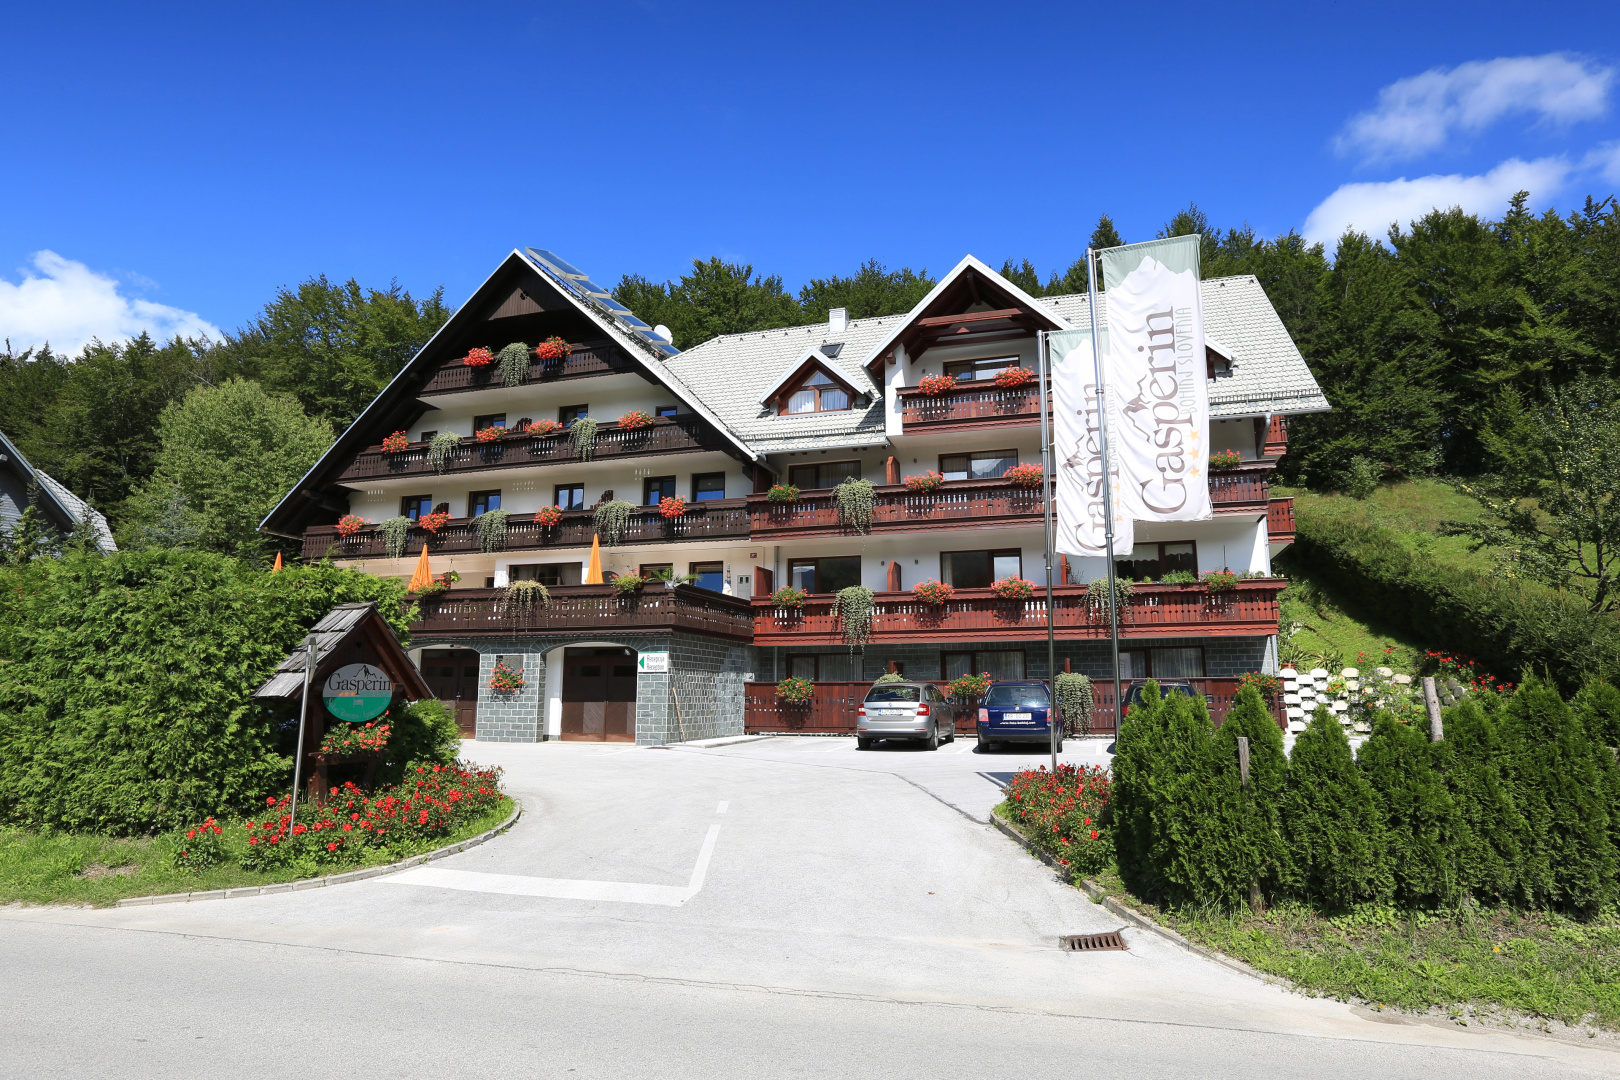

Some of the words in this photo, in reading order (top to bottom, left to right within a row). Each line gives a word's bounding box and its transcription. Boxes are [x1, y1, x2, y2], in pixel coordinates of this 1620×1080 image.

[1175, 306, 1194, 365] SLOVENIA
[1137, 305, 1194, 515] Gasperin
[1178, 371, 1198, 414] BOHINJ
[328, 672, 391, 695] Gasperin
